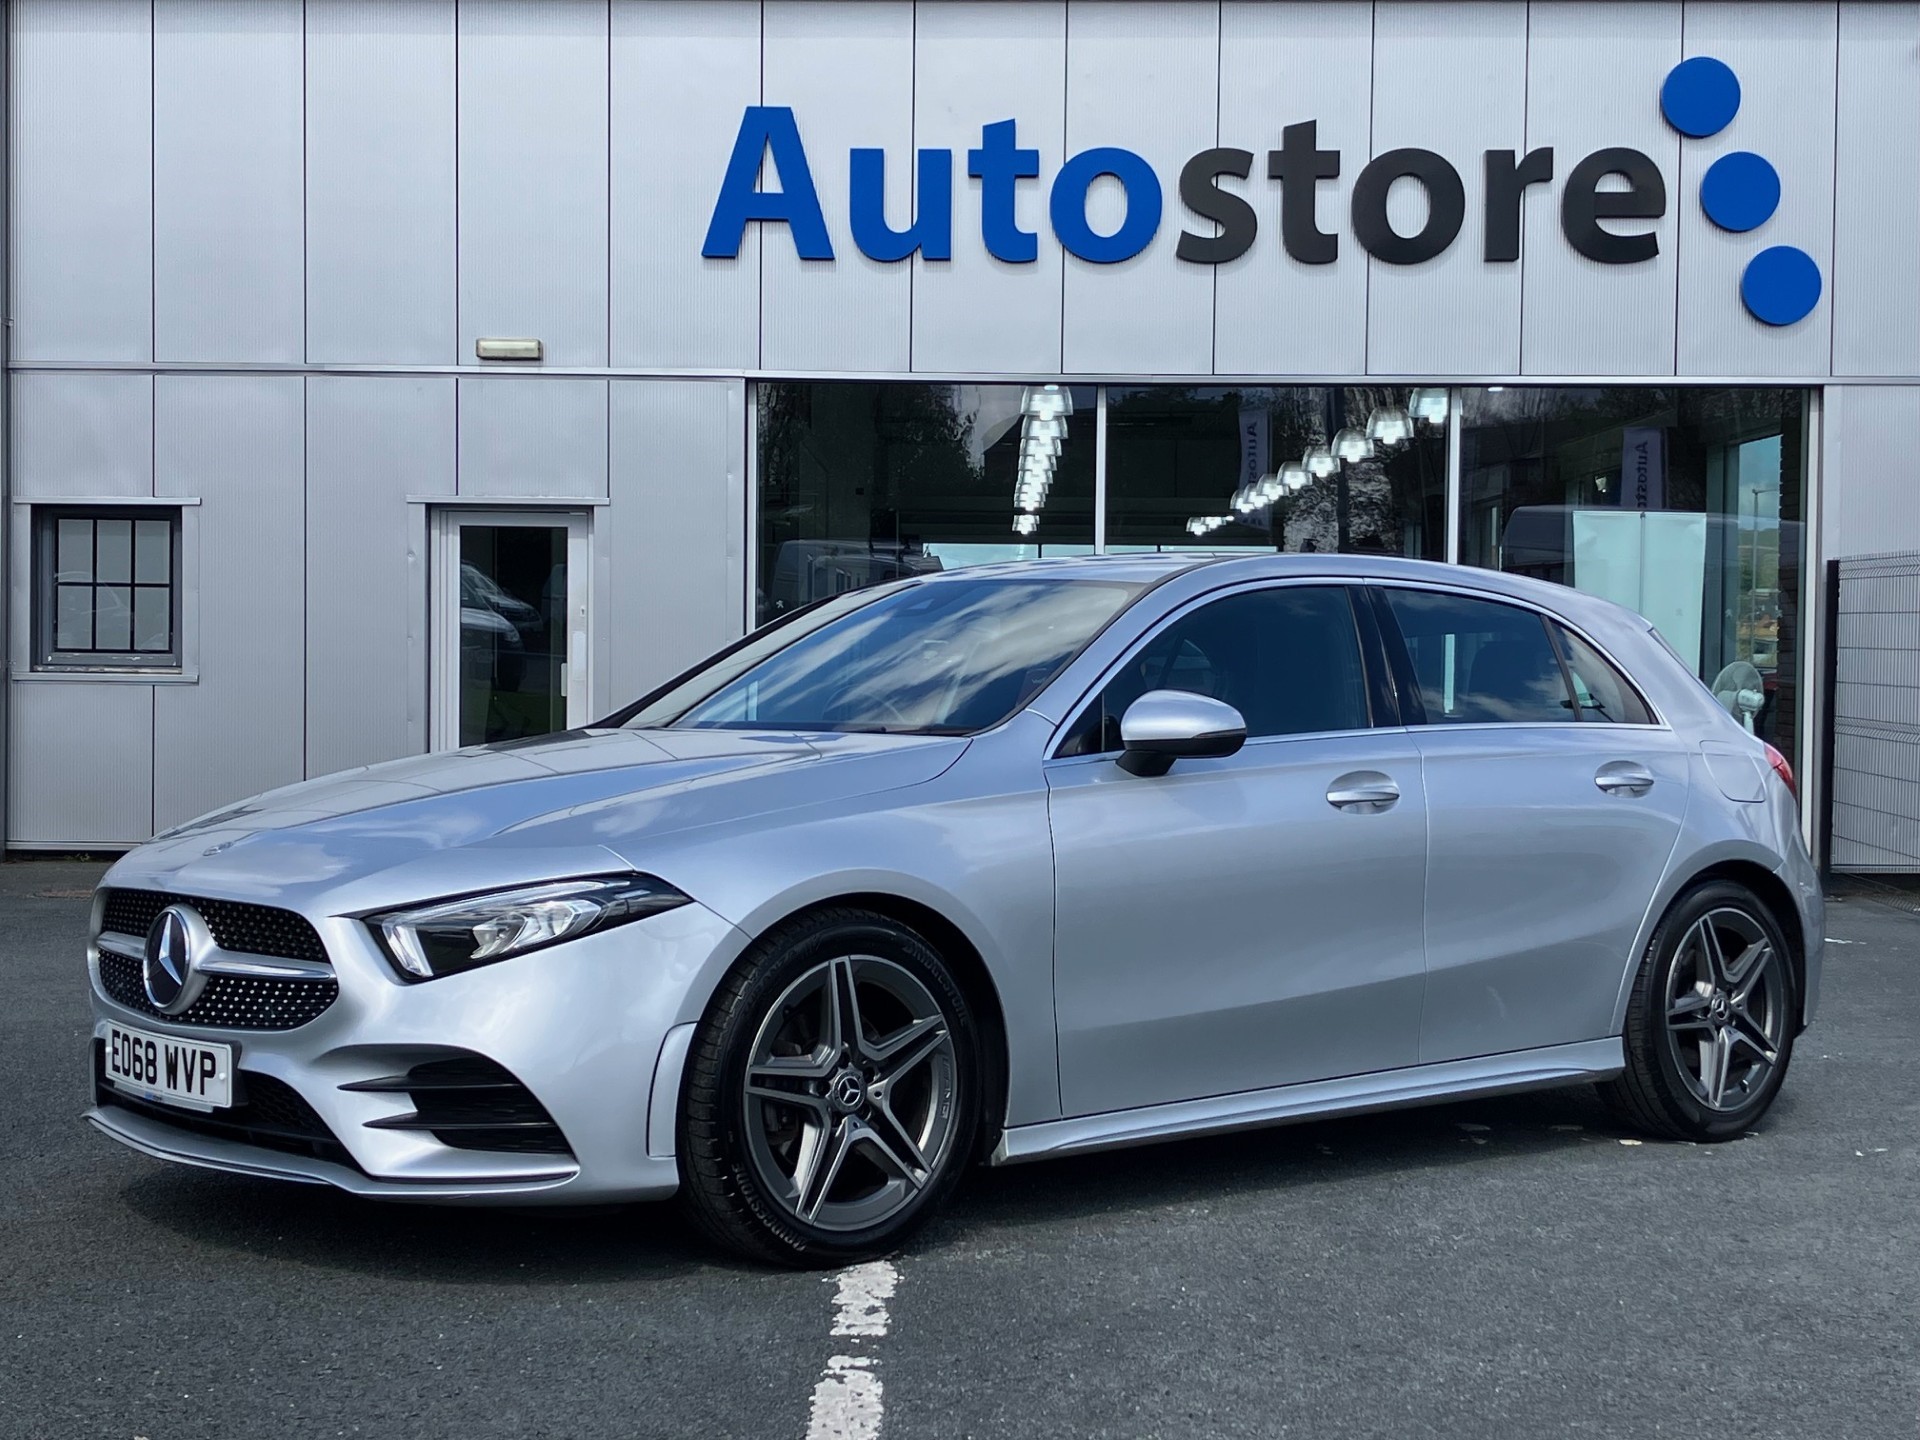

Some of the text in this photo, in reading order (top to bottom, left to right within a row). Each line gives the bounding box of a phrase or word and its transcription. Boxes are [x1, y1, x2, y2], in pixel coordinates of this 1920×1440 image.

[702, 106, 1667, 265] Autostore
[112, 1029, 216, 1095] EO68 WVP
[731, 1163, 808, 1252] BRIDGESTONE
